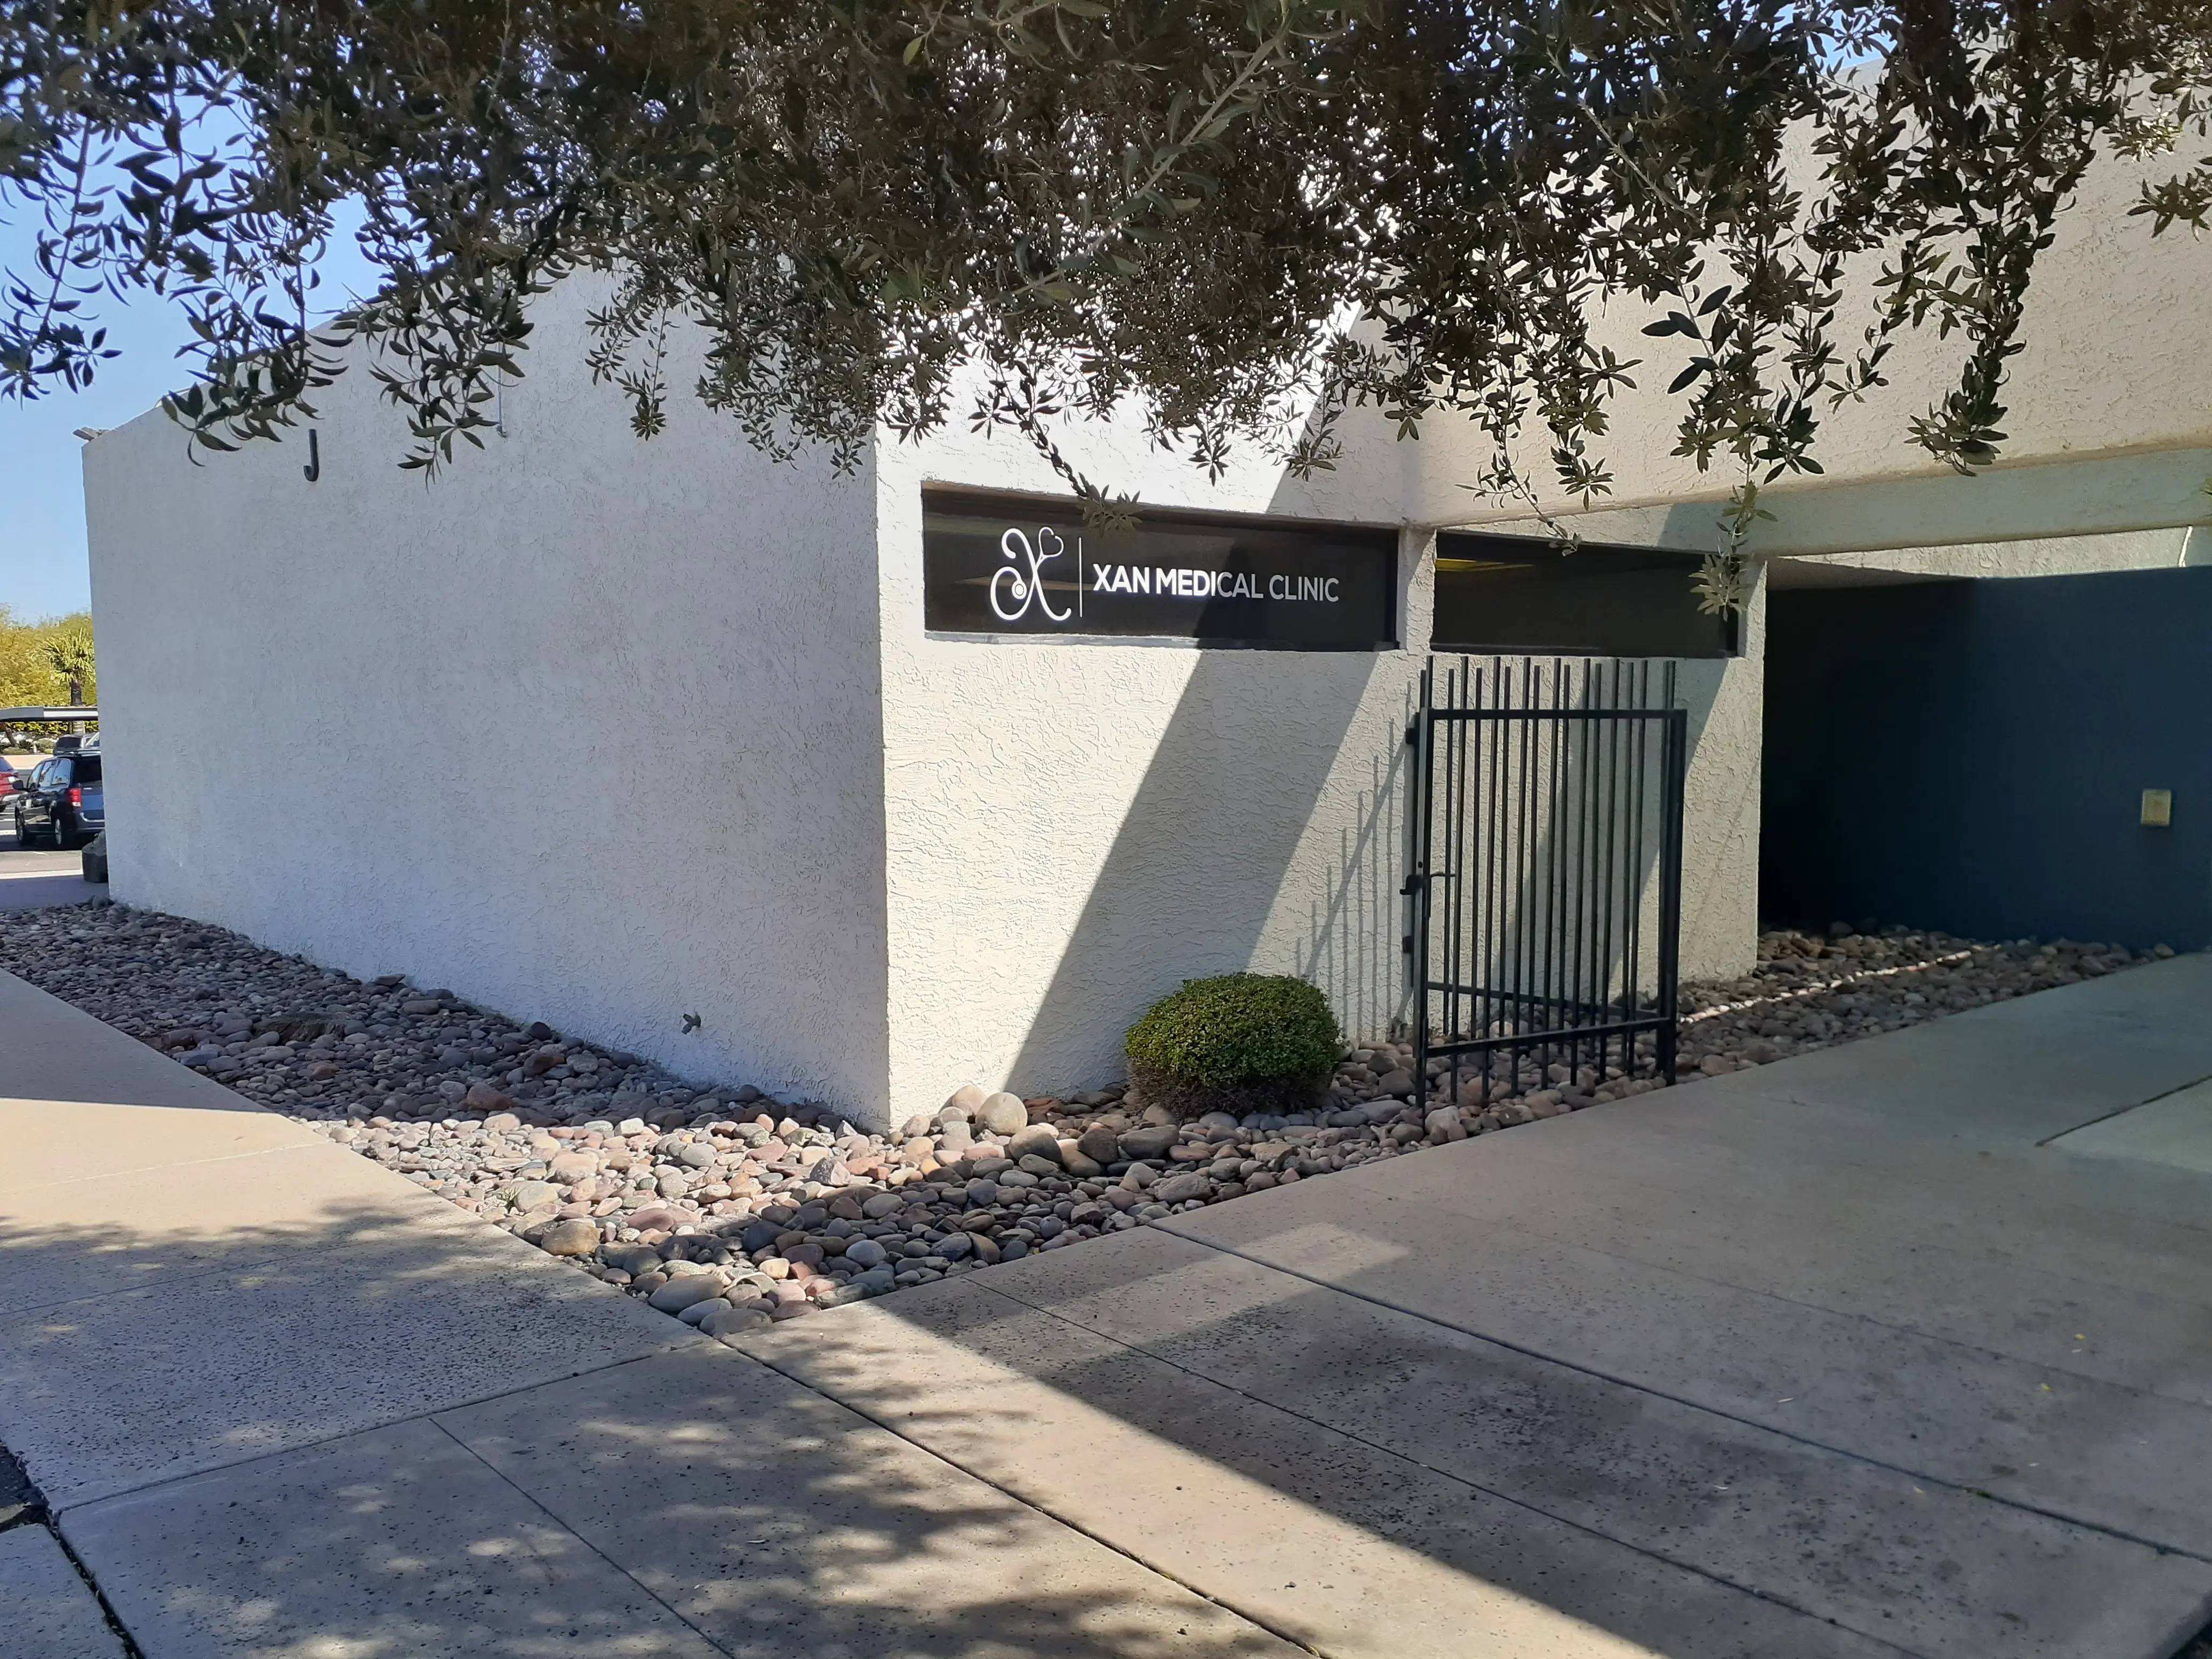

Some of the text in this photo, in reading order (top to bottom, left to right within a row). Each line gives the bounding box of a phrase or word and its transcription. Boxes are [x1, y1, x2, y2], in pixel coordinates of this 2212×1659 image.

[1092, 563, 1340, 603] XAN MEDICAL CLINIC
